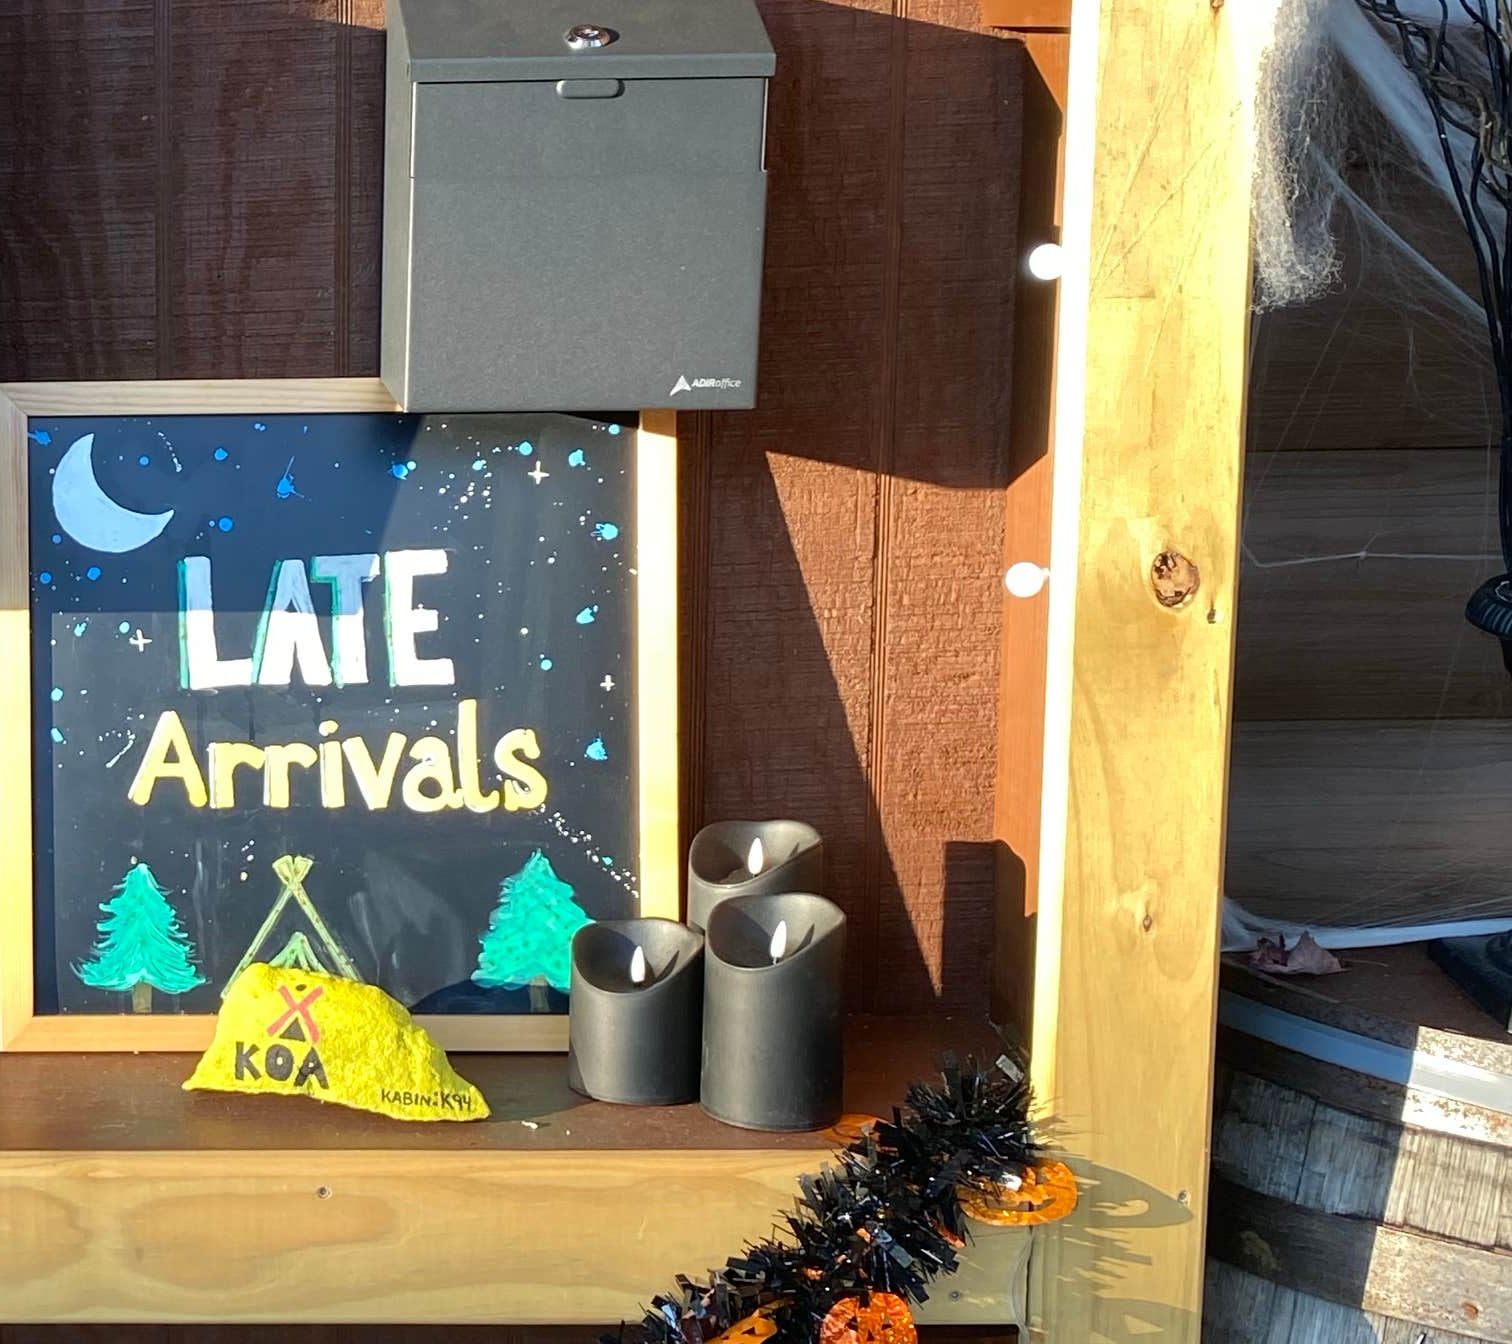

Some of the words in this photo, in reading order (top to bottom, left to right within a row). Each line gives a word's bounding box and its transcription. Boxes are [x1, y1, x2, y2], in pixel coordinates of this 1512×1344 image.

[177, 549, 455, 690] LATE
[127, 699, 548, 813] Arrivals
[234, 1041, 329, 1089] KOA
